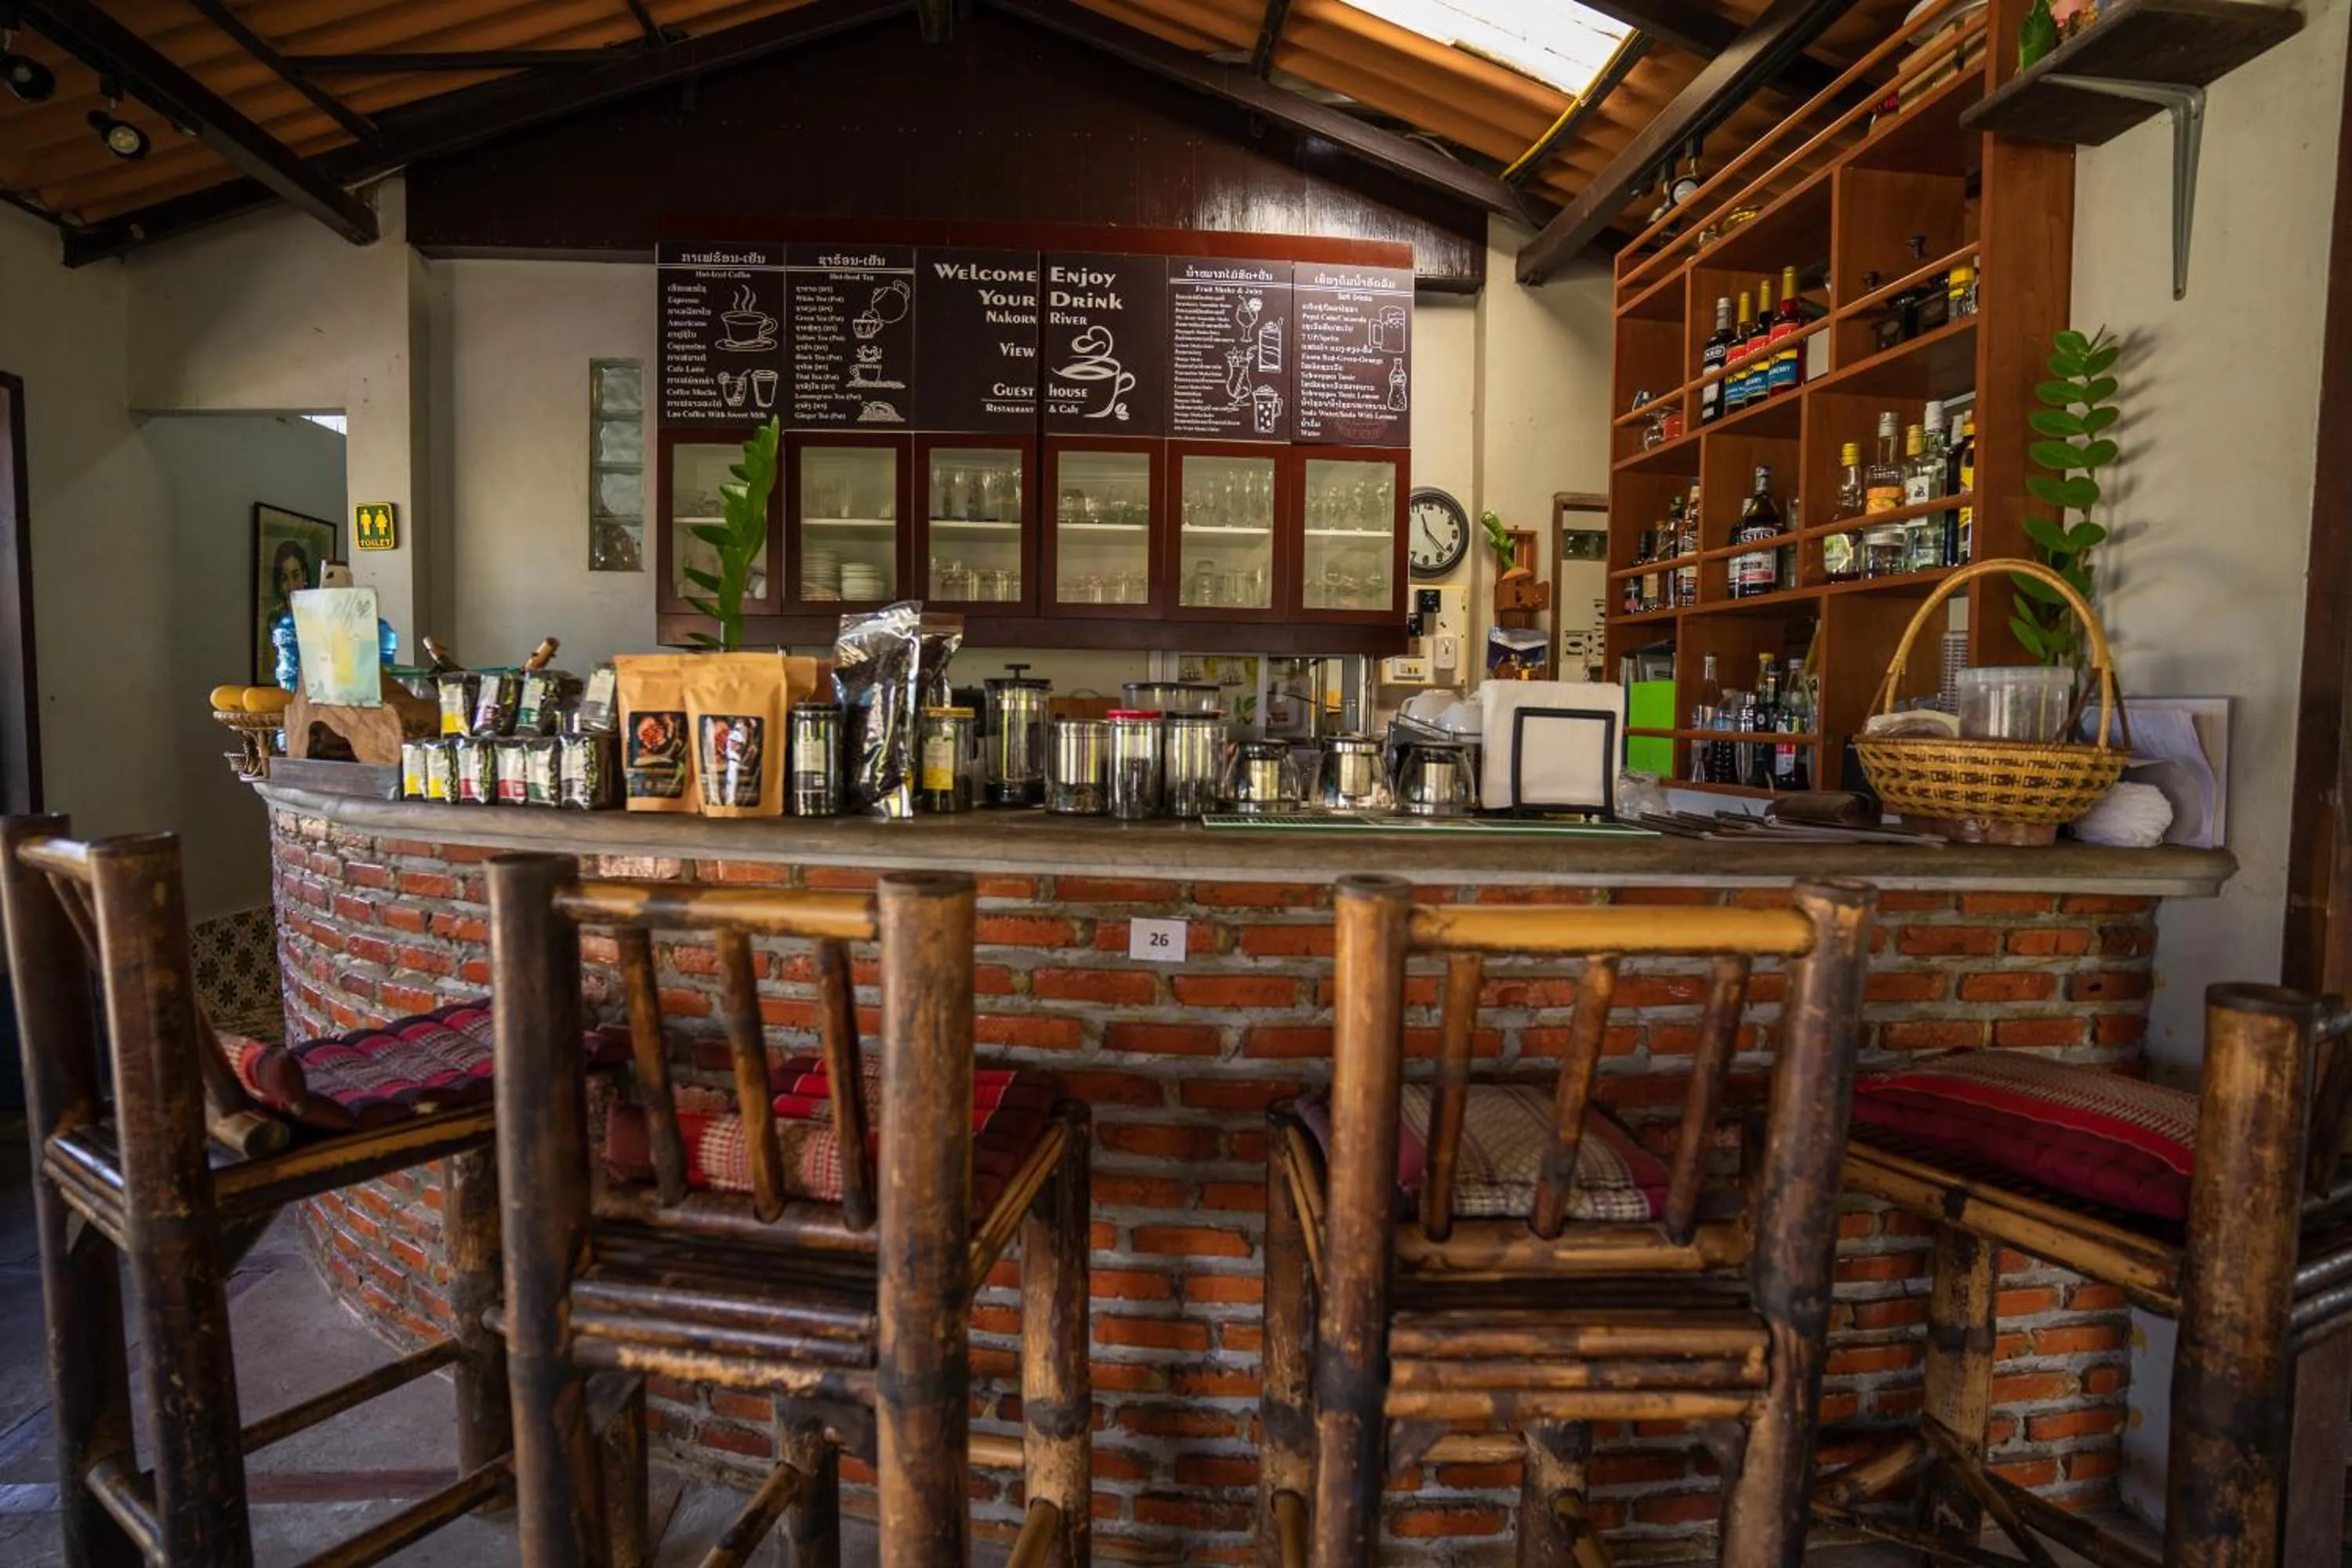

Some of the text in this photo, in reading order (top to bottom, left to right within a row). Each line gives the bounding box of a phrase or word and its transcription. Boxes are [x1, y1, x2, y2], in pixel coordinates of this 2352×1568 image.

[1051, 267, 1115, 288] Enjoy
[978, 290, 1123, 309] Your Drink
[986, 310, 1087, 325] Nakorn River
[1000, 343, 1035, 357] View
[993, 383, 1034, 397] Guest
[360, 539, 390, 547] TOILET
[1149, 932, 1169, 947] 26
